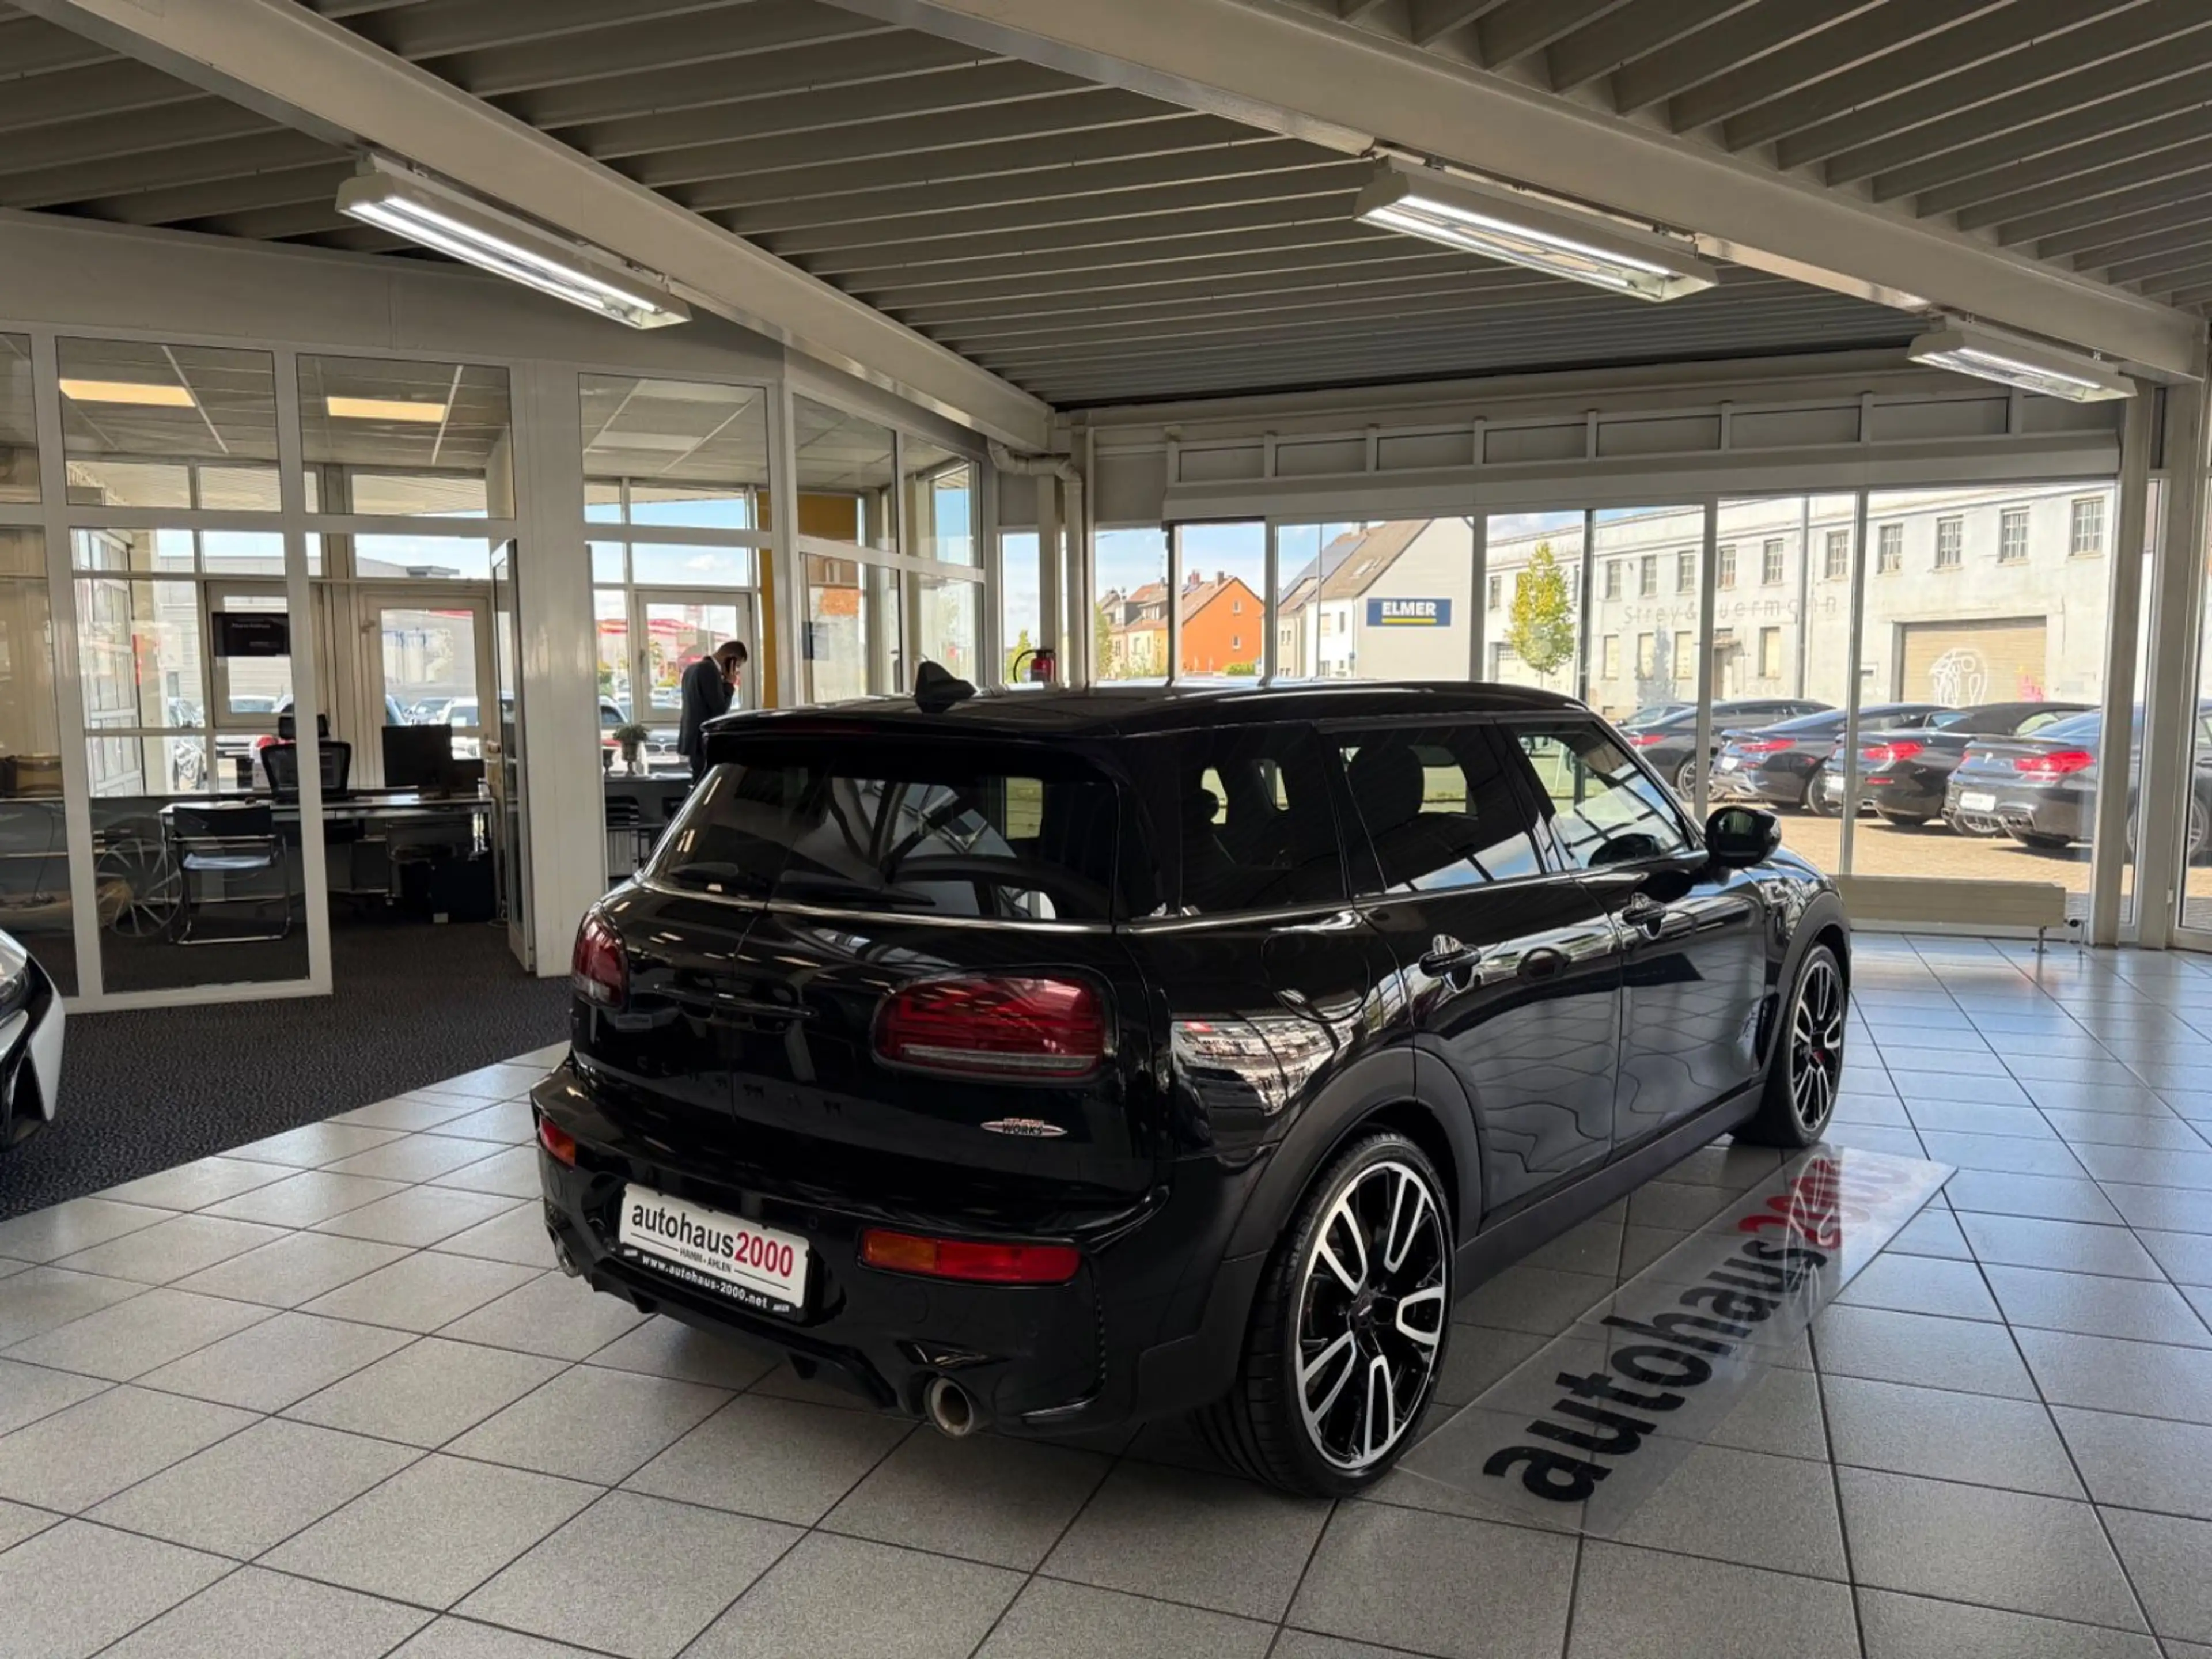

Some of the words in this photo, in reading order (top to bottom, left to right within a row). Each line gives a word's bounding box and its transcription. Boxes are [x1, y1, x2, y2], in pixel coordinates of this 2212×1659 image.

[1382, 601, 1437, 616] ELMER
[632, 1204, 794, 1278] autohaus2000
[642, 1255, 768, 1308] www.autohaus-2000.net
